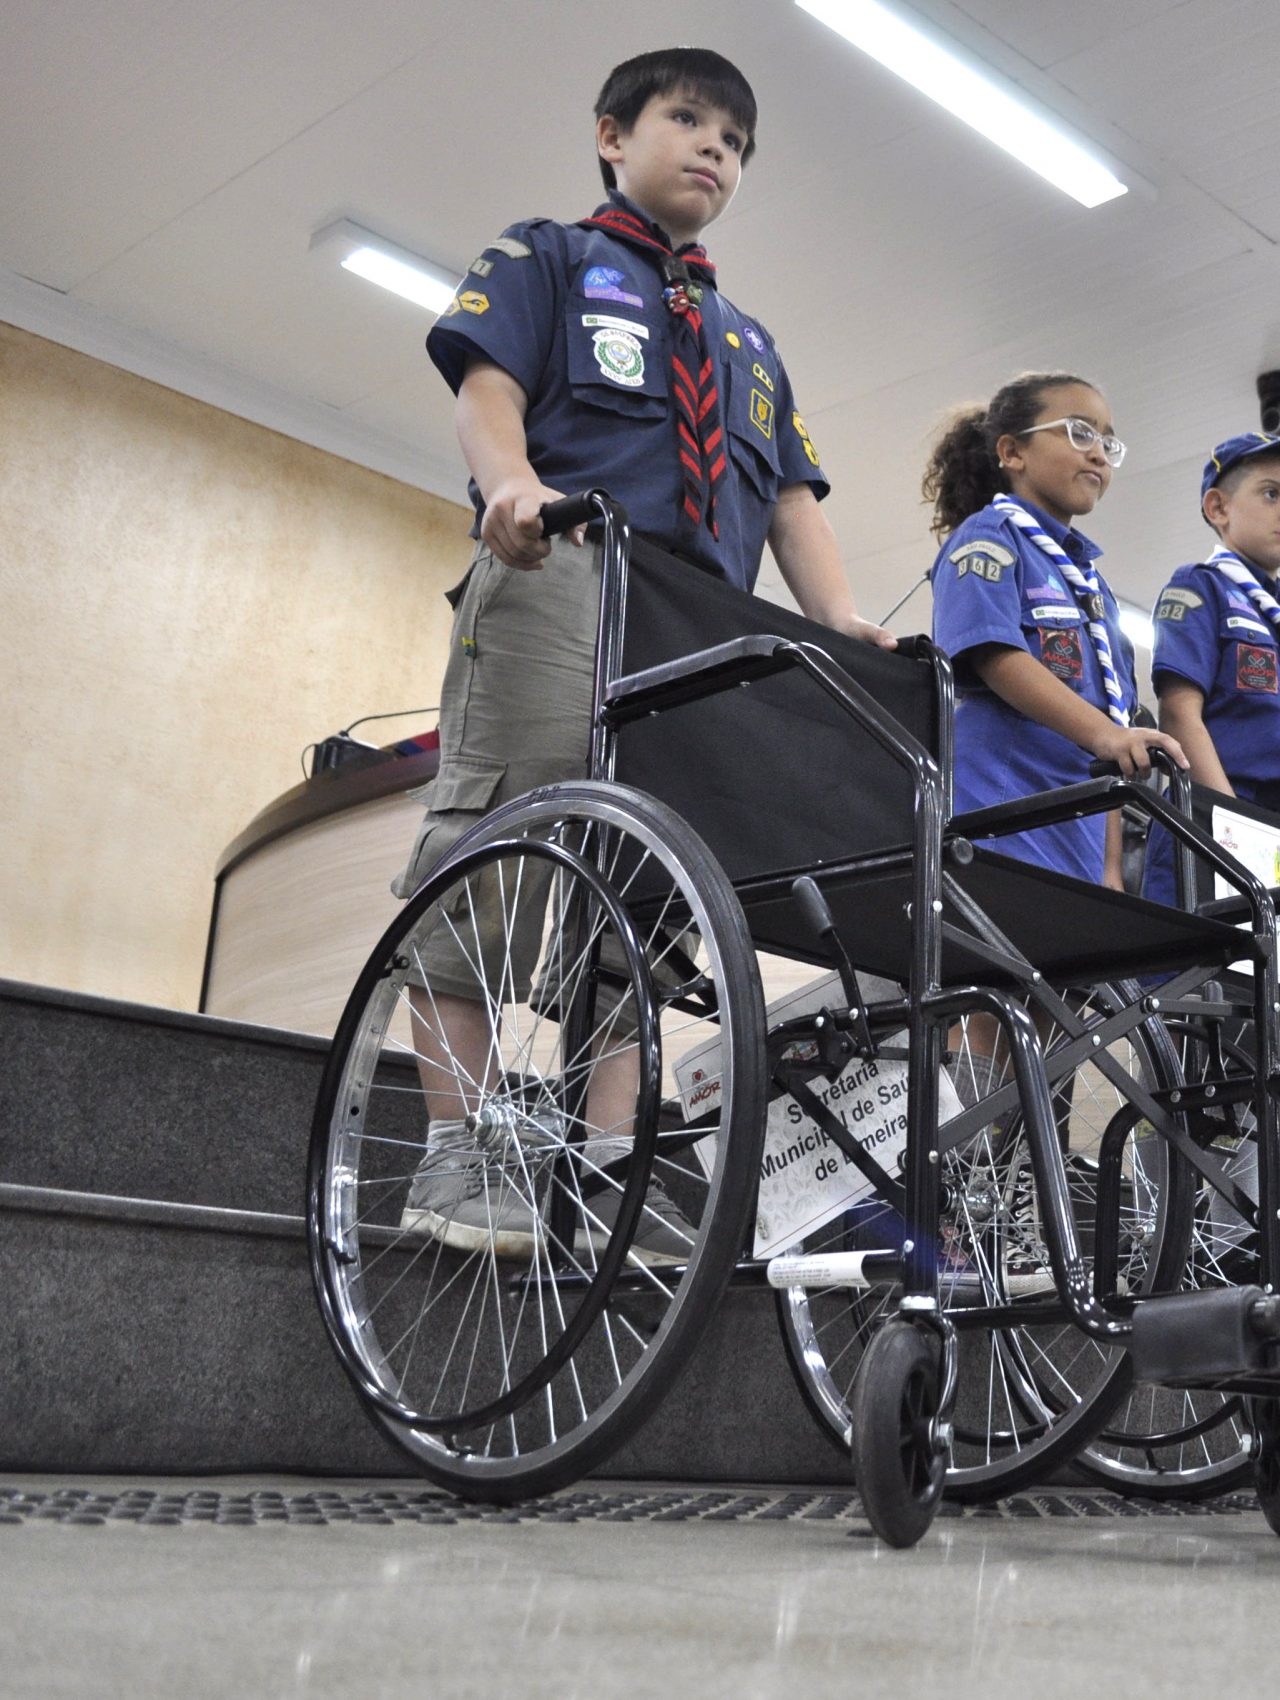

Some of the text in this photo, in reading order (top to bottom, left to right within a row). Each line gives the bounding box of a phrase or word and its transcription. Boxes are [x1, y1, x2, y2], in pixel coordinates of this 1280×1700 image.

[787, 1062, 880, 1124] Sretaria
[760, 1110, 849, 1181] Municipl
[852, 1100, 876, 1122] de
[815, 1158, 839, 1181] de
